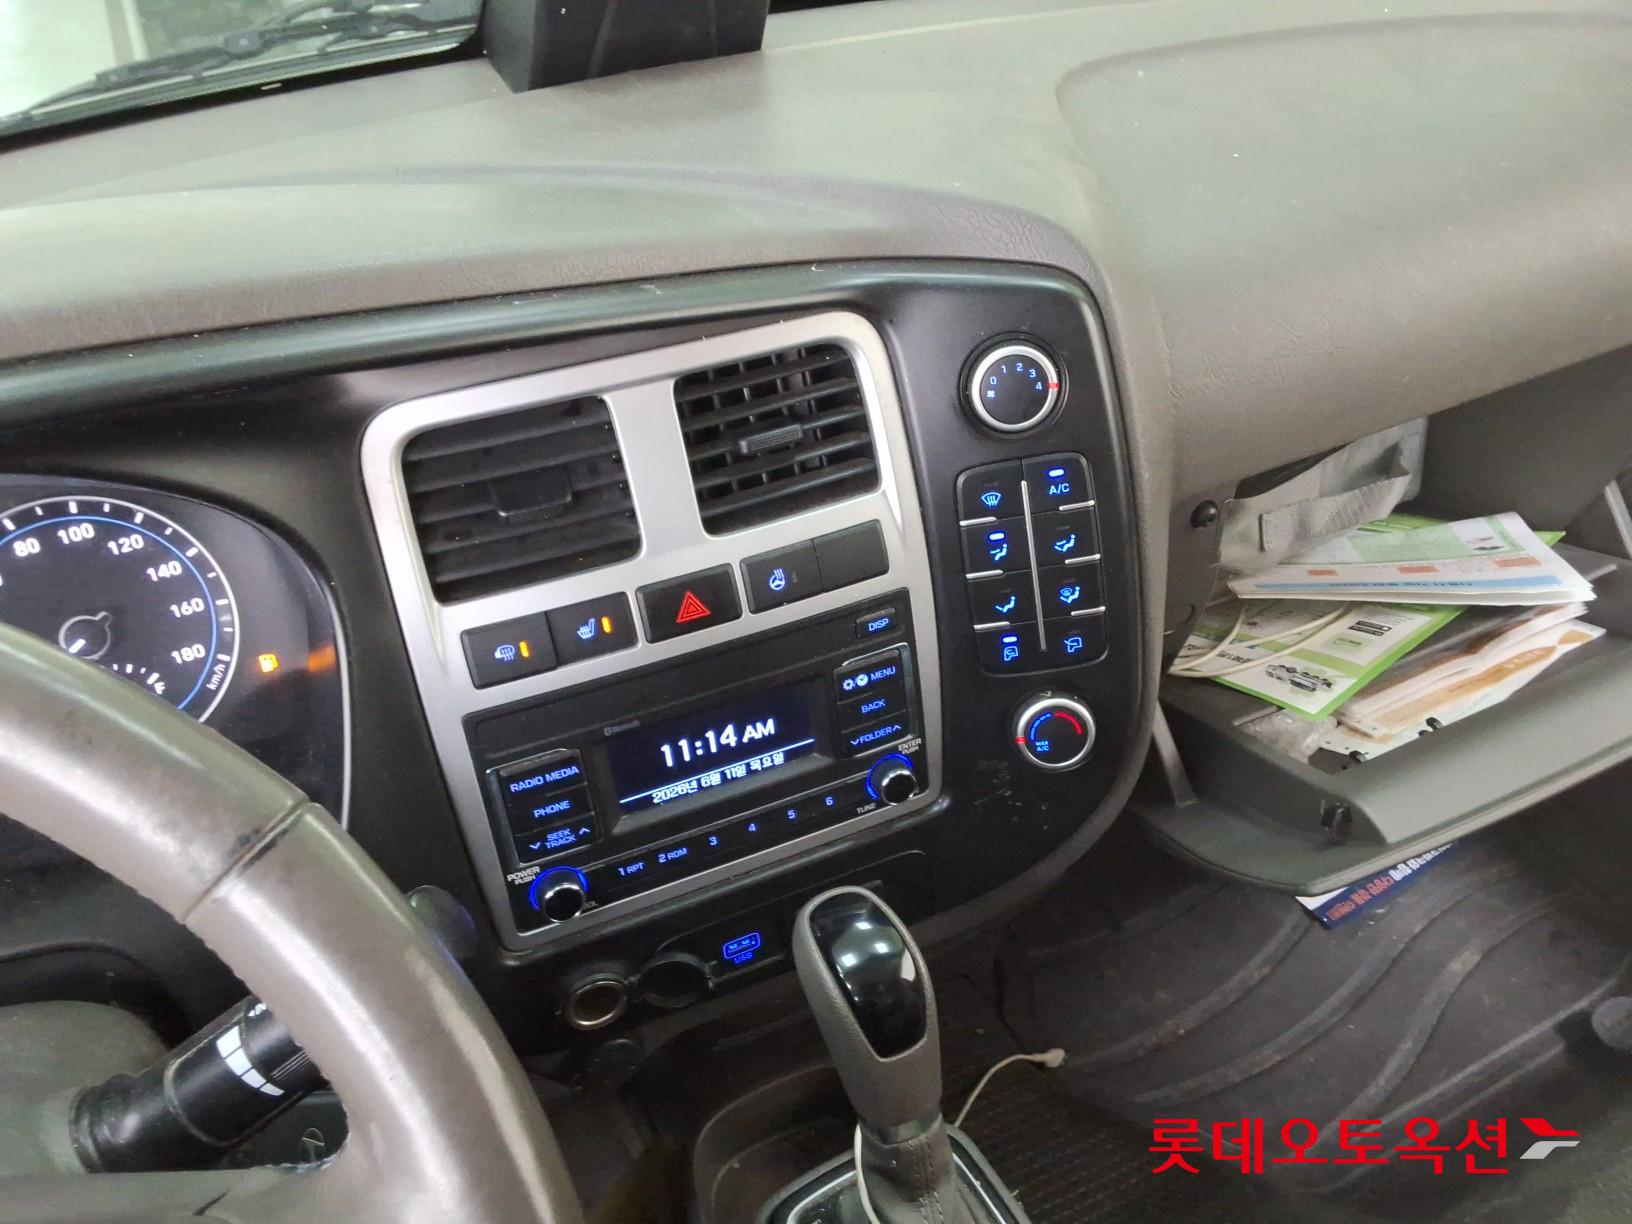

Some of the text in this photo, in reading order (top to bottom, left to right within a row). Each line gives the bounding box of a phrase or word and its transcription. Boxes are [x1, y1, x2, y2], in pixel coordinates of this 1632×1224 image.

[1001, 365, 1007, 374] 1
[1016, 363, 1024, 372] 2
[1029, 369, 1036, 378] 3
[1035, 381, 1043, 391] 4
[1049, 483, 1070, 495] A/C
[56, 522, 95, 545] 100
[12, 537, 41, 557] 80
[107, 533, 145, 556] 120
[146, 560, 183, 581] 140
[169, 597, 205, 618] 160
[868, 618, 889, 632] DISP
[170, 643, 206, 664] 180
[206, 663, 226, 691] km/h
[871, 666, 896, 681] MENU
[861, 699, 886, 713] BACK
[860, 726, 892, 743] FOLDER
[660, 724, 738, 767] 11:14
[742, 718, 776, 743] AM
[510, 766, 580, 793] RADIO MEDIA
[651, 752, 784, 803] 2026년 6월 11일 목요일
[533, 800, 572, 818] PHONE
[825, 796, 834, 807] 6
[787, 809, 796, 819] 5
[546, 828, 571, 841] SEEK
[748, 823, 757, 832] 4
[544, 834, 577, 849] TRACK
[709, 836, 718, 846] 3
[658, 847, 688, 863] 2 RDM
[506, 866, 540, 882] POWER
[617, 862, 645, 876] 1 RPT
